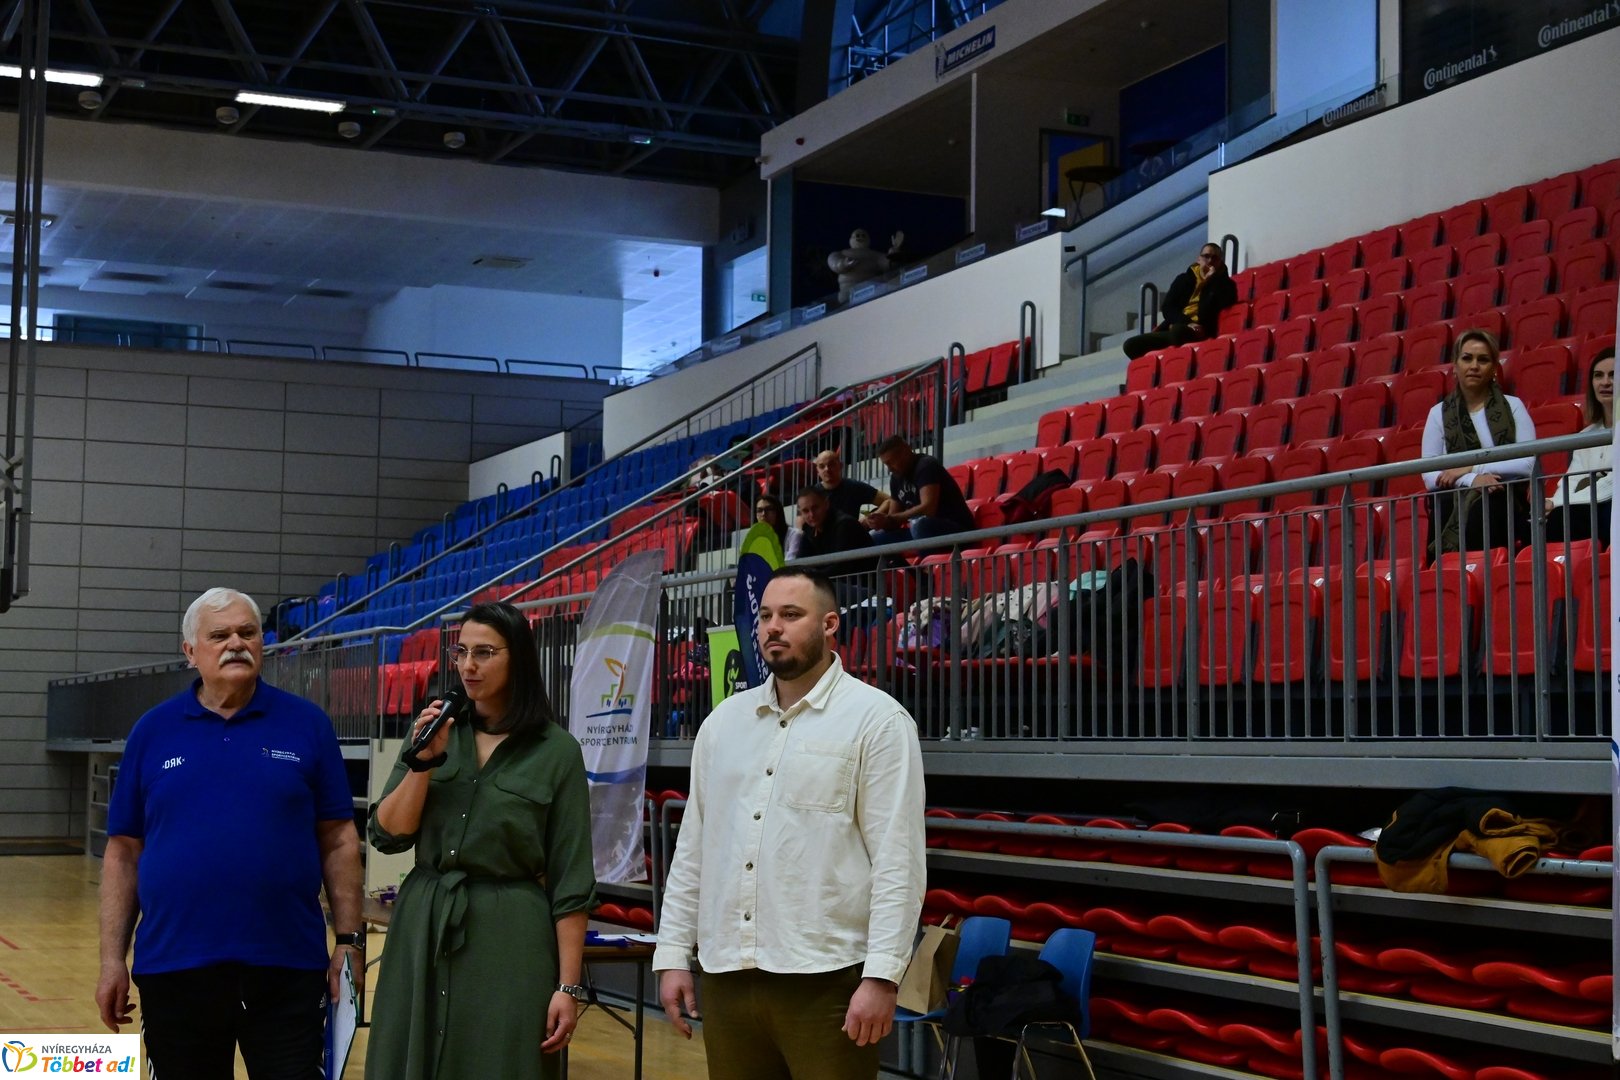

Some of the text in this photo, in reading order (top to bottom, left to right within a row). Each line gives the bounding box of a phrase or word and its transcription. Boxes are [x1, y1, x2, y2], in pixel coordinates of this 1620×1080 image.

[1537, 3, 1610, 48] Continental
[947, 30, 994, 66] MICHELIN
[1422, 48, 1487, 90] Continental
[1322, 90, 1379, 127] Continental
[580, 736, 638, 747] SPORCENTRM
